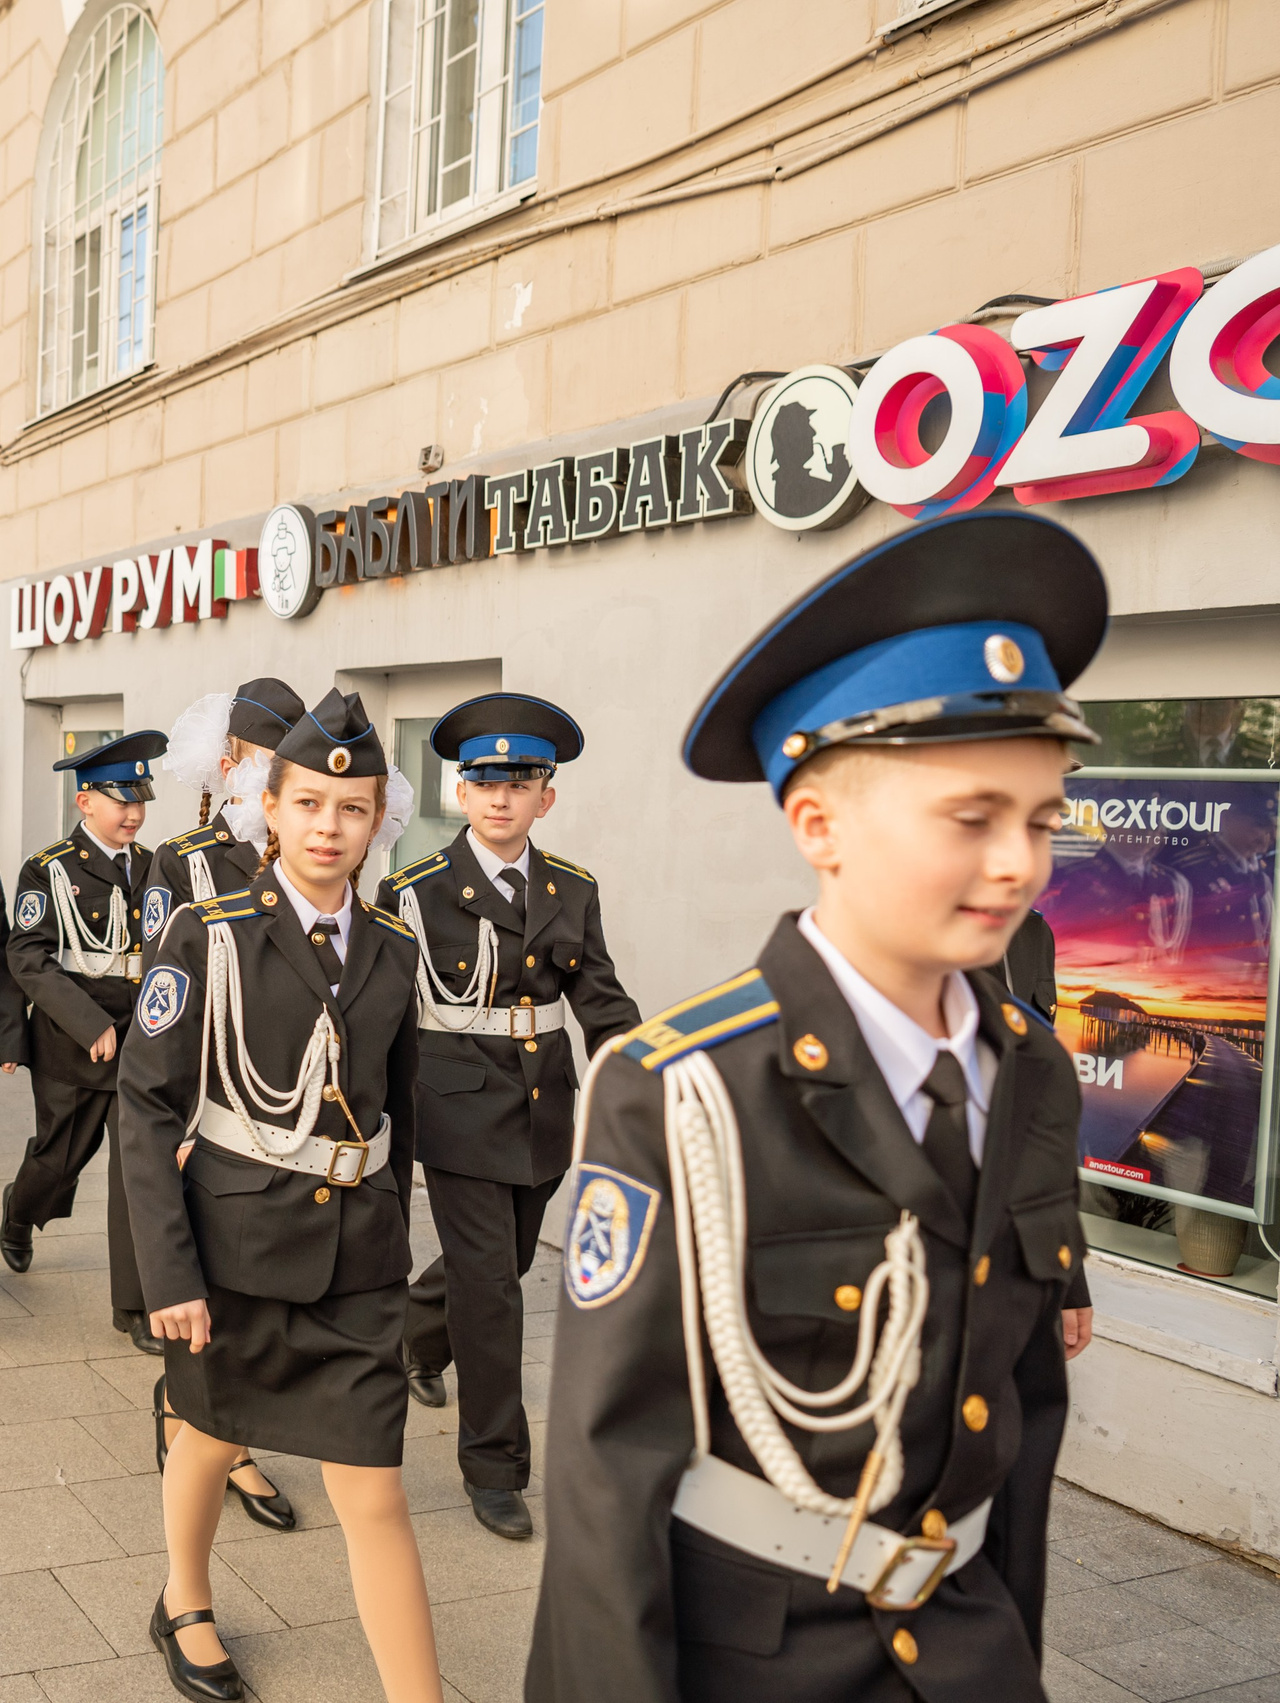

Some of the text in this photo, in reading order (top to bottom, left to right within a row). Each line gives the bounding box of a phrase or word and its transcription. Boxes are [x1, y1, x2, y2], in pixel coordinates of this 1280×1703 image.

[484, 418, 735, 555] ТАБАК
[315, 490, 419, 588] БАБЛ
[10, 538, 214, 649] ШОУ РУМ
[1061, 796, 1232, 833] anextour
[1085, 832, 1189, 847] ТУРАГЕНТСТВО
[1088, 1160, 1145, 1180] anextour.com
